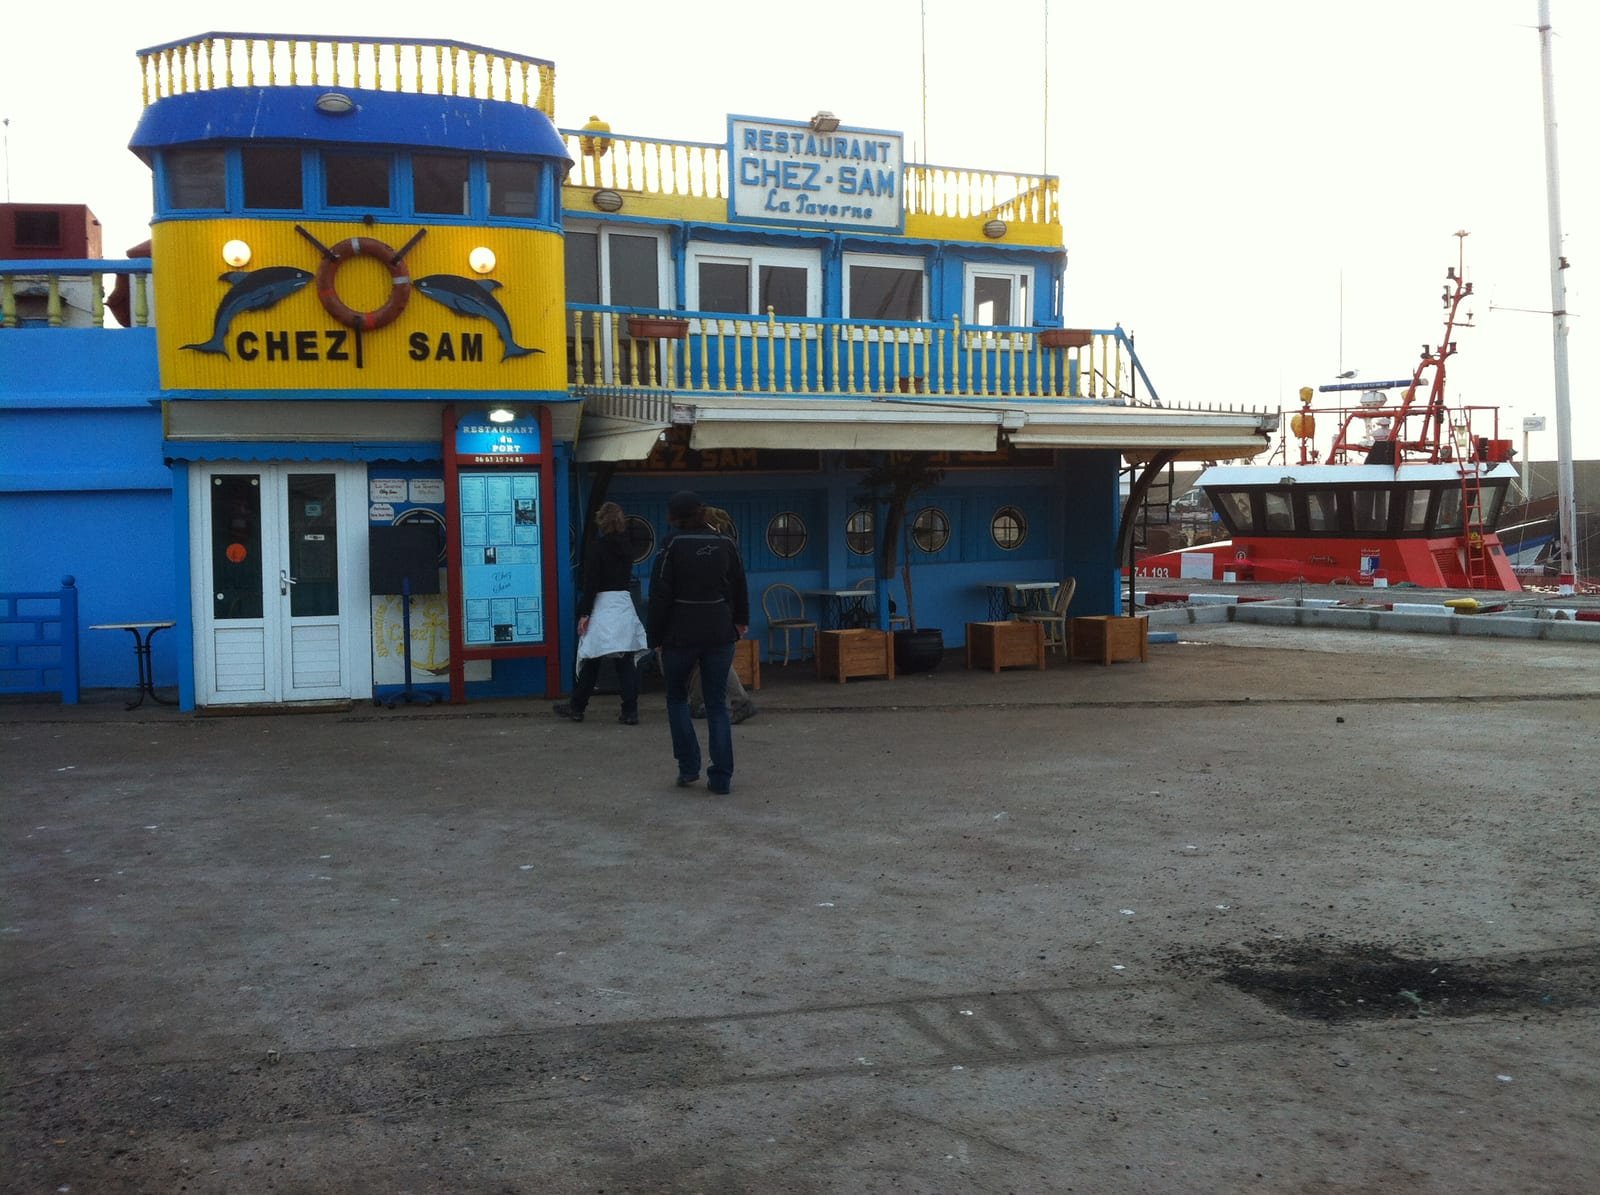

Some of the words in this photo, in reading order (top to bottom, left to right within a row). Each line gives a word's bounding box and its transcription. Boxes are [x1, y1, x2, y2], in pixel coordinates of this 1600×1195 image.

[744, 128, 890, 163] RESTAURANT
[741, 157, 820, 191] CHEZ
[838, 165, 895, 198] SAM
[765, 189, 790, 212] La
[796, 193, 873, 219] Taverne
[236, 331, 349, 362] CHEZ
[408, 331, 484, 362] SAM
[492, 445, 521, 453] PORT
